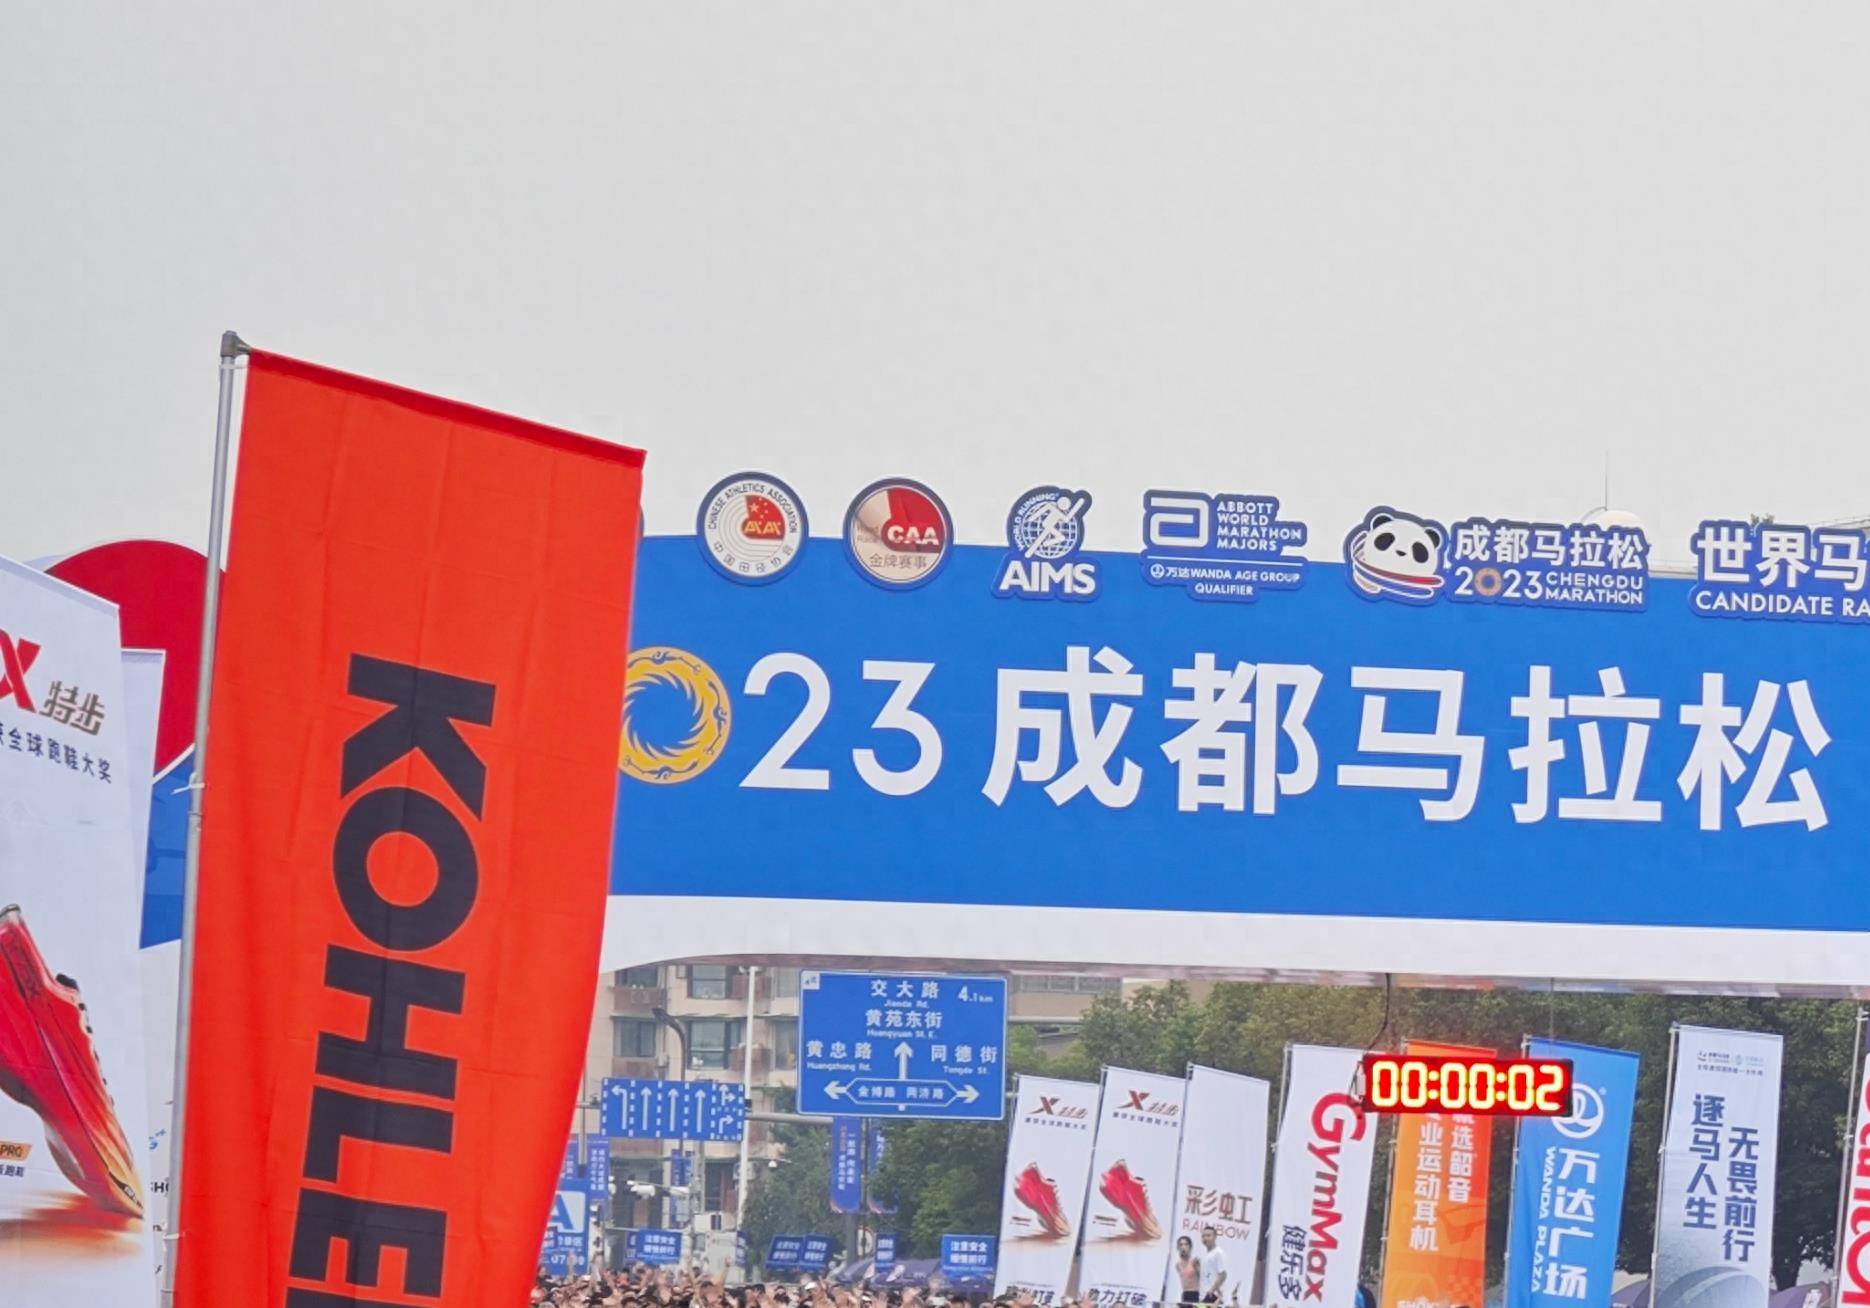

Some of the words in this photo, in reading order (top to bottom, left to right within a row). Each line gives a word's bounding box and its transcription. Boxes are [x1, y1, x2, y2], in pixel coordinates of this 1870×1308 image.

[1217, 500, 1274, 515] ABBOTT
[1217, 513, 1269, 527] WORLD
[887, 525, 939, 545] CAA
[1216, 538, 1278, 552] MAJORS
[1217, 525, 1302, 541] MARATHON
[1454, 523, 1644, 571] 成都马拉松
[869, 553, 928, 569] 金牌赛事
[999, 560, 1096, 595] AIMS
[1235, 571, 1258, 582] AGE
[1260, 571, 1300, 583] GROUP
[1194, 582, 1254, 597] QUALIFIER
[1454, 566, 1543, 600] 2023
[1545, 587, 1644, 605] MARATHON
[1546, 572, 1644, 590] CHENGDU
[1695, 590, 1835, 617] CANDIDATE
[39, 680, 106, 737] 特步
[0, 722, 112, 784] 全球跑鞋大奖
[981, 645, 1833, 834] 成都马拉松
[870, 979, 940, 999] 交大路
[865, 1009, 942, 1029] 黄苑东街
[807, 1040, 873, 1060] 黄忠路
[930, 1045, 998, 1064] 同德街
[1371, 1059, 1566, 1112] 00:00:02
[1682, 1093, 1727, 1230] 逐马人生
[1304, 1092, 1367, 1302] GymMax
[1409, 1114, 1444, 1252] 业运动耳机
[1538, 1145, 1557, 1220] WANDA
[1722, 1126, 1760, 1263] 无畏前行
[1184, 1184, 1253, 1226] 彩虹
[1544, 1147, 1599, 1300] 万达广场
[1277, 1224, 1305, 1302] 健乐多
[1530, 1225, 1548, 1294] PLAZA
